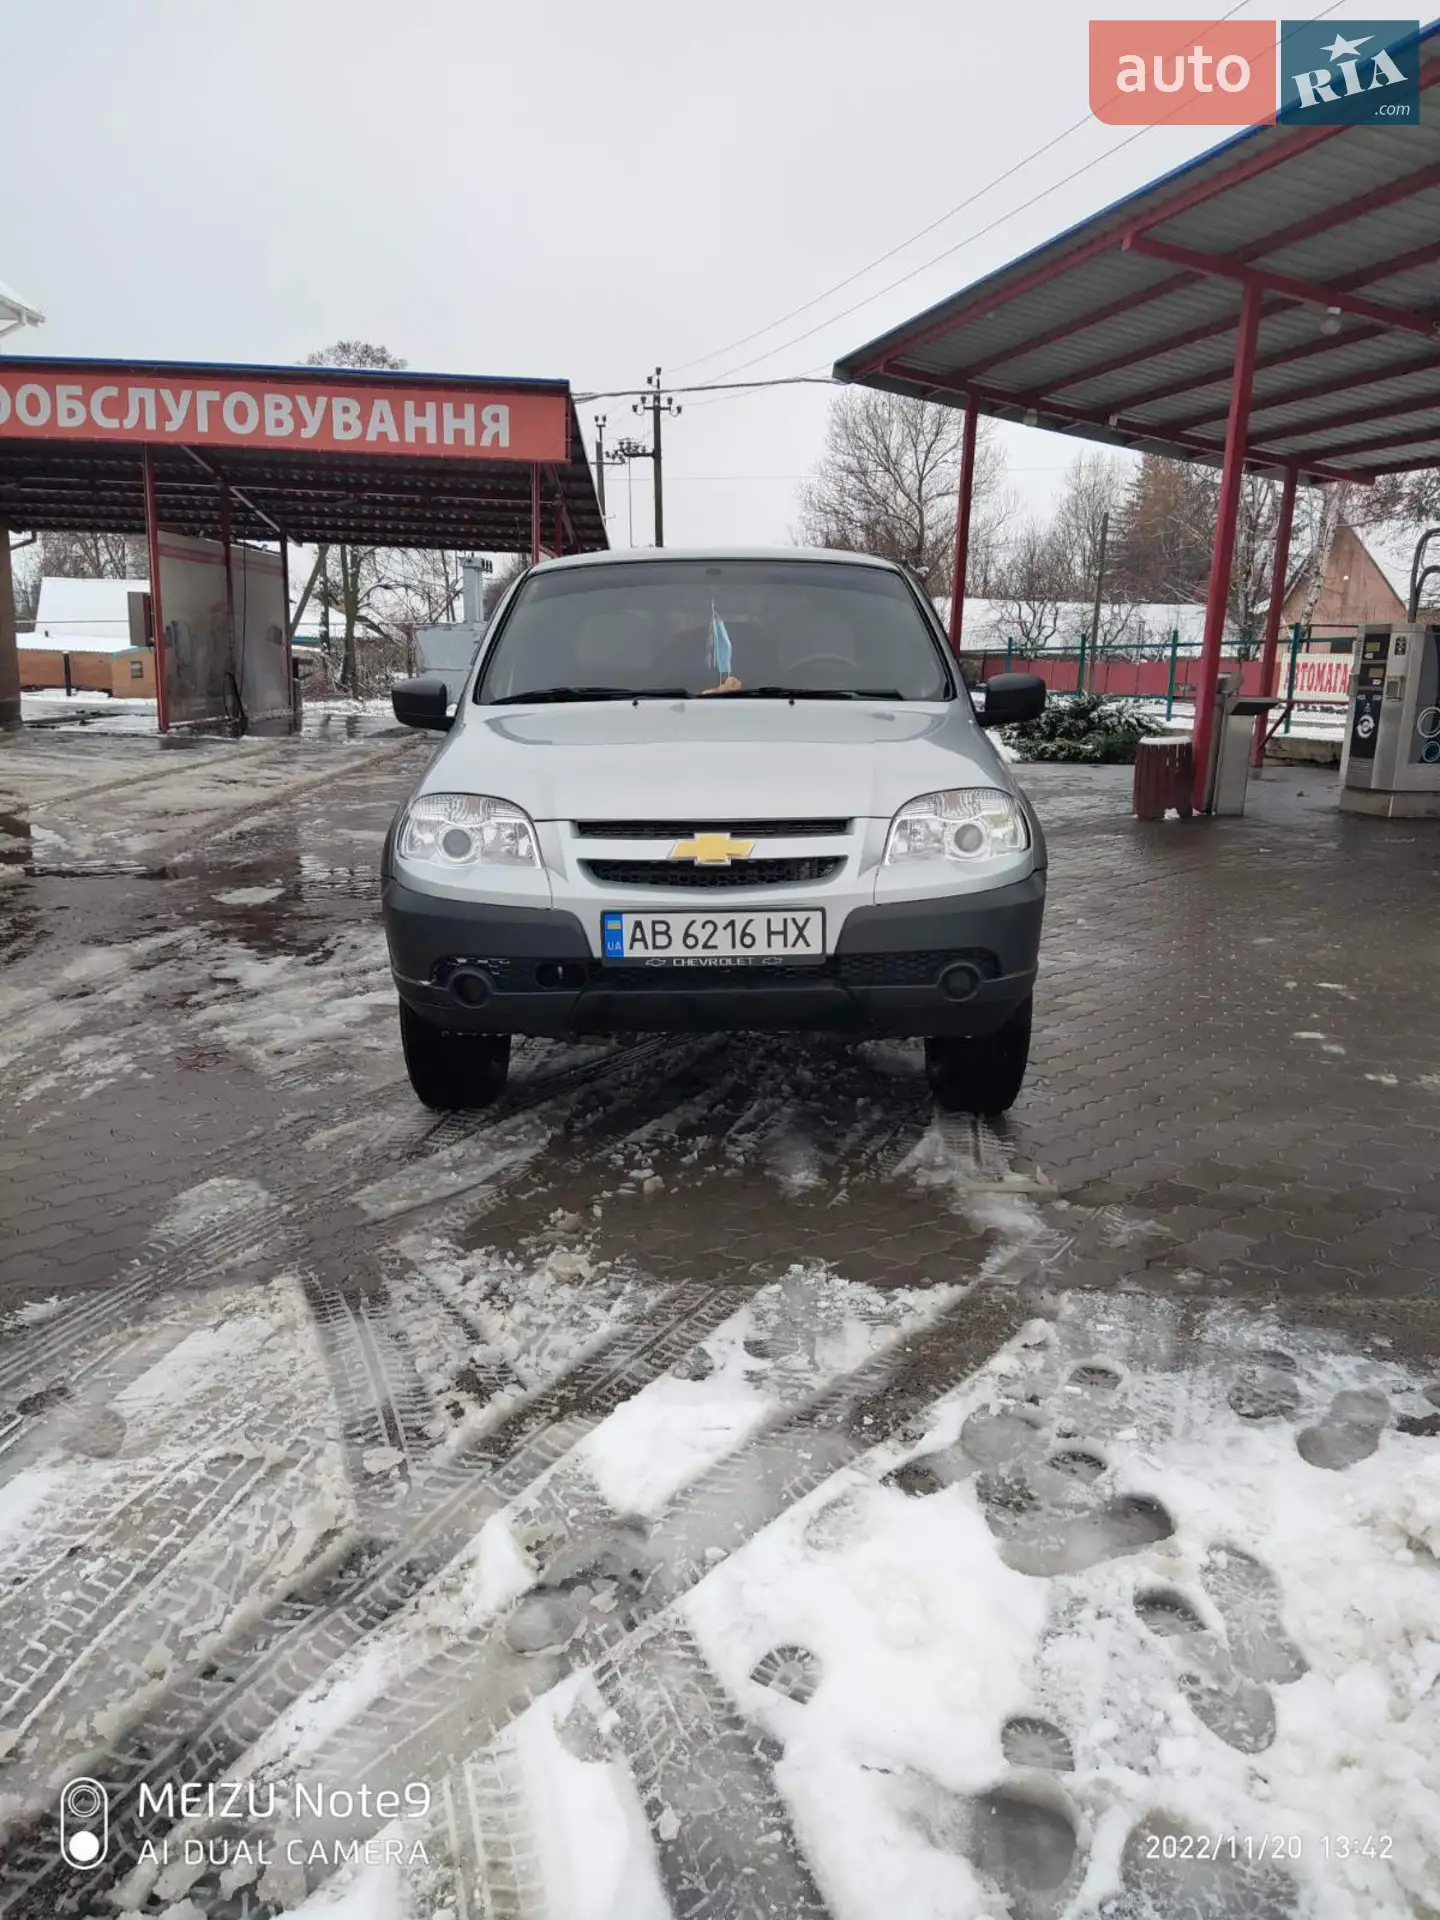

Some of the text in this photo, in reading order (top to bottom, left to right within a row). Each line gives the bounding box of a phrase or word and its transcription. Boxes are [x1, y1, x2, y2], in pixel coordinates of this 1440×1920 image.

[628, 917, 812, 951] AB 6216 HX
[607, 941, 622, 952] UA
[672, 957, 754, 967] CHEVROLET
